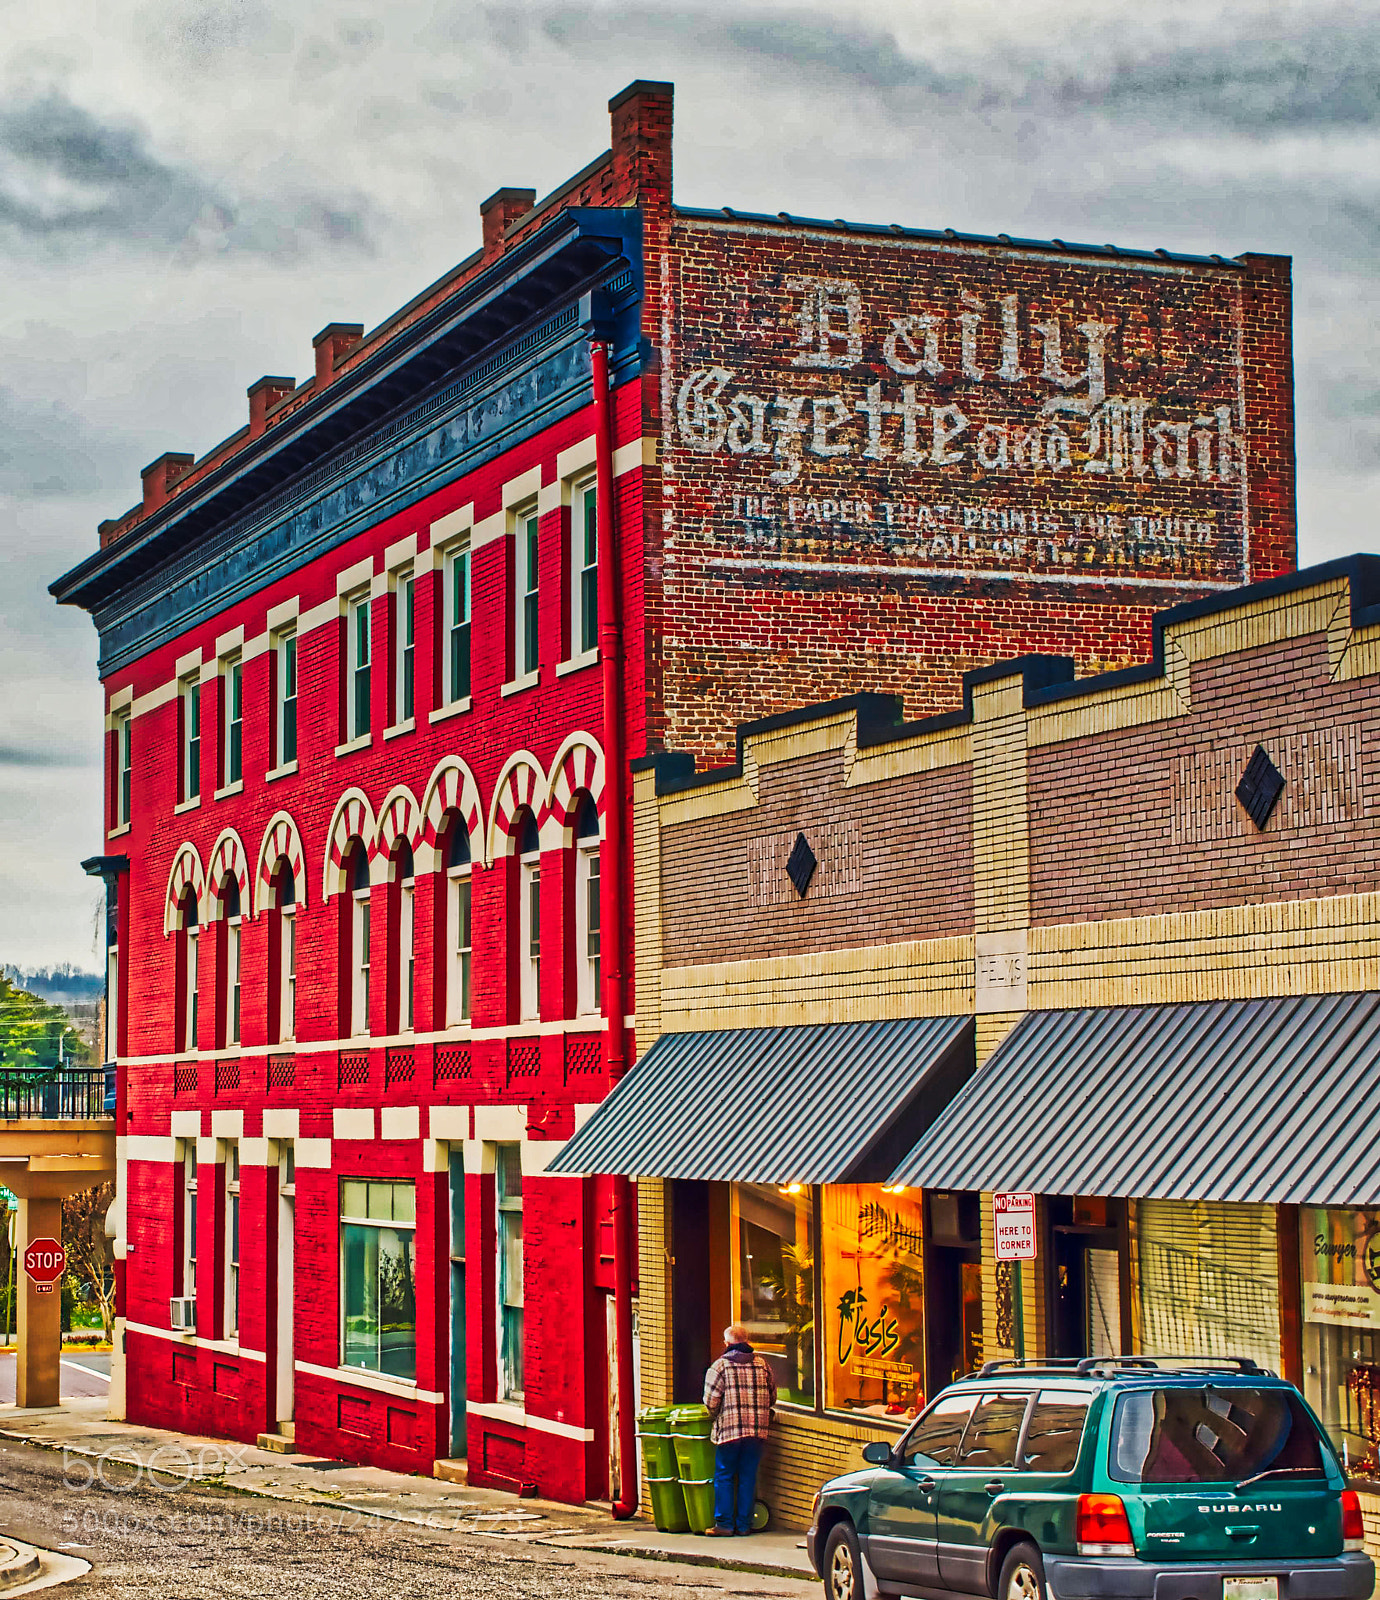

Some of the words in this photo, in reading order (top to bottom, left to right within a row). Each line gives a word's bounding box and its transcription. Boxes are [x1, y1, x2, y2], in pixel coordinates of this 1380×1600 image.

[785, 274, 1114, 416] Daily
[676, 366, 971, 485] Gazette
[732, 494, 775, 520] THE
[788, 497, 873, 524] PAPER
[881, 501, 951, 529] THAT
[1127, 516, 1211, 543] TRUTH
[995, 1197, 1006, 1210] NO
[1007, 1198, 1032, 1208] PARKING
[999, 1226, 1019, 1236] HERE
[1021, 1226, 1031, 1235] TO
[1000, 1240, 1031, 1250] CORNER
[1313, 1233, 1357, 1264] Sawyer
[26, 1252, 63, 1269] STOP
[1198, 1503, 1282, 1513] SUBARU
